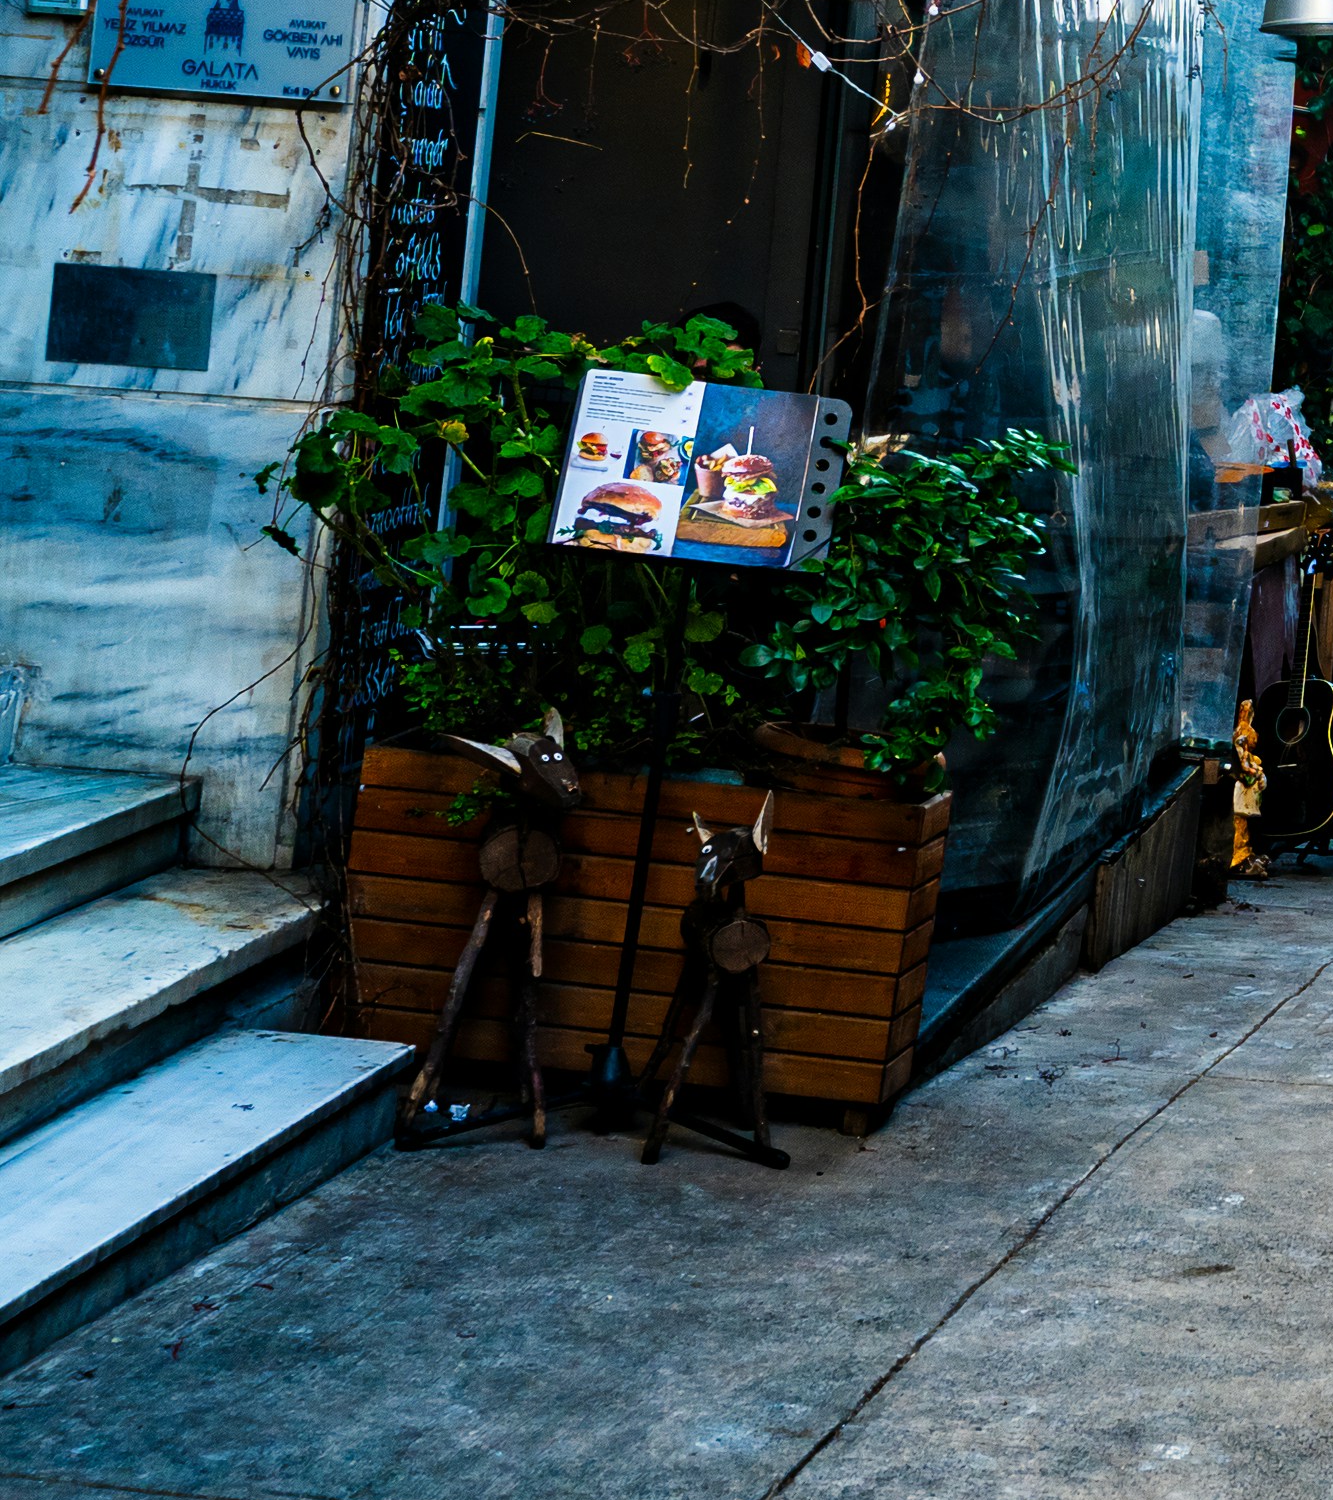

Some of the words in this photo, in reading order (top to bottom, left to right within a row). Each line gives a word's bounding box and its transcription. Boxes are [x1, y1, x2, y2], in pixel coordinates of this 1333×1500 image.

[288, 19, 328, 30] AVUKAT
[181, 59, 259, 81] GALATA
[201, 77, 237, 91] HUKUK
